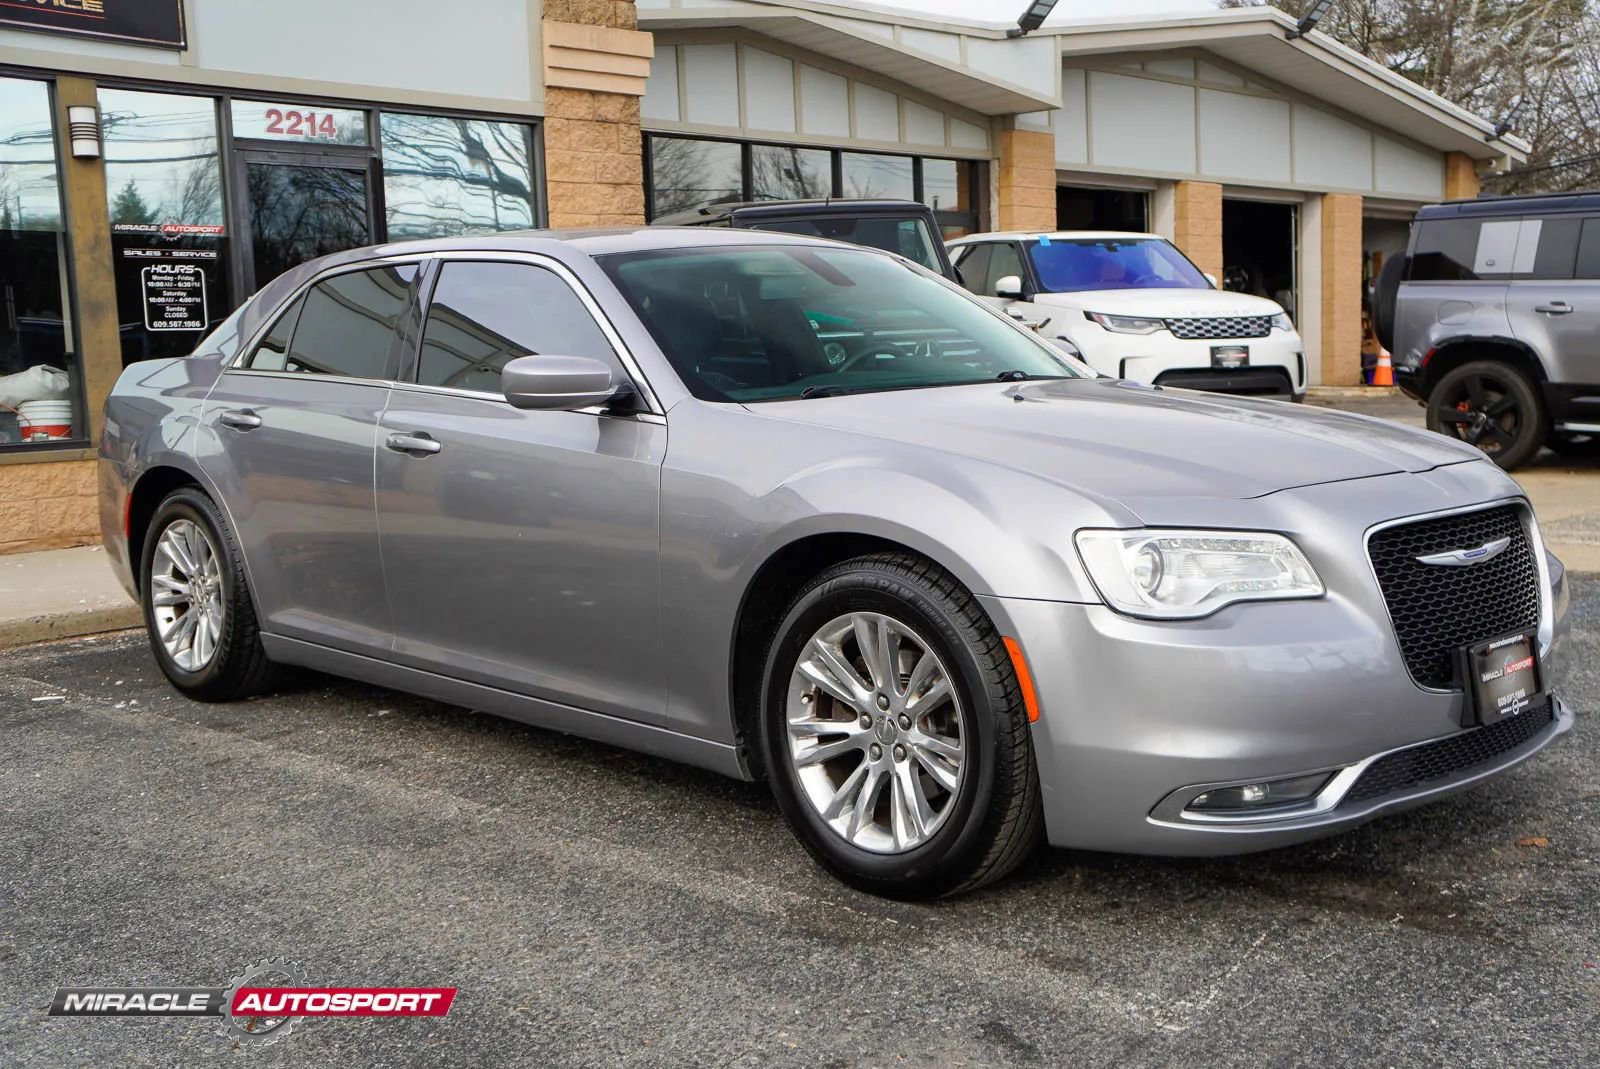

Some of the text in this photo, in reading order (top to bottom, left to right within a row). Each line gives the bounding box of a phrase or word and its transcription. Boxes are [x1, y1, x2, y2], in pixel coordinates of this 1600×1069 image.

[265, 108, 337, 138] 2214
[114, 224, 221, 233] MIRACLE AUTOSPORT
[151, 264, 195, 274] HOURS
[1482, 668, 1504, 682] MIRACLE
